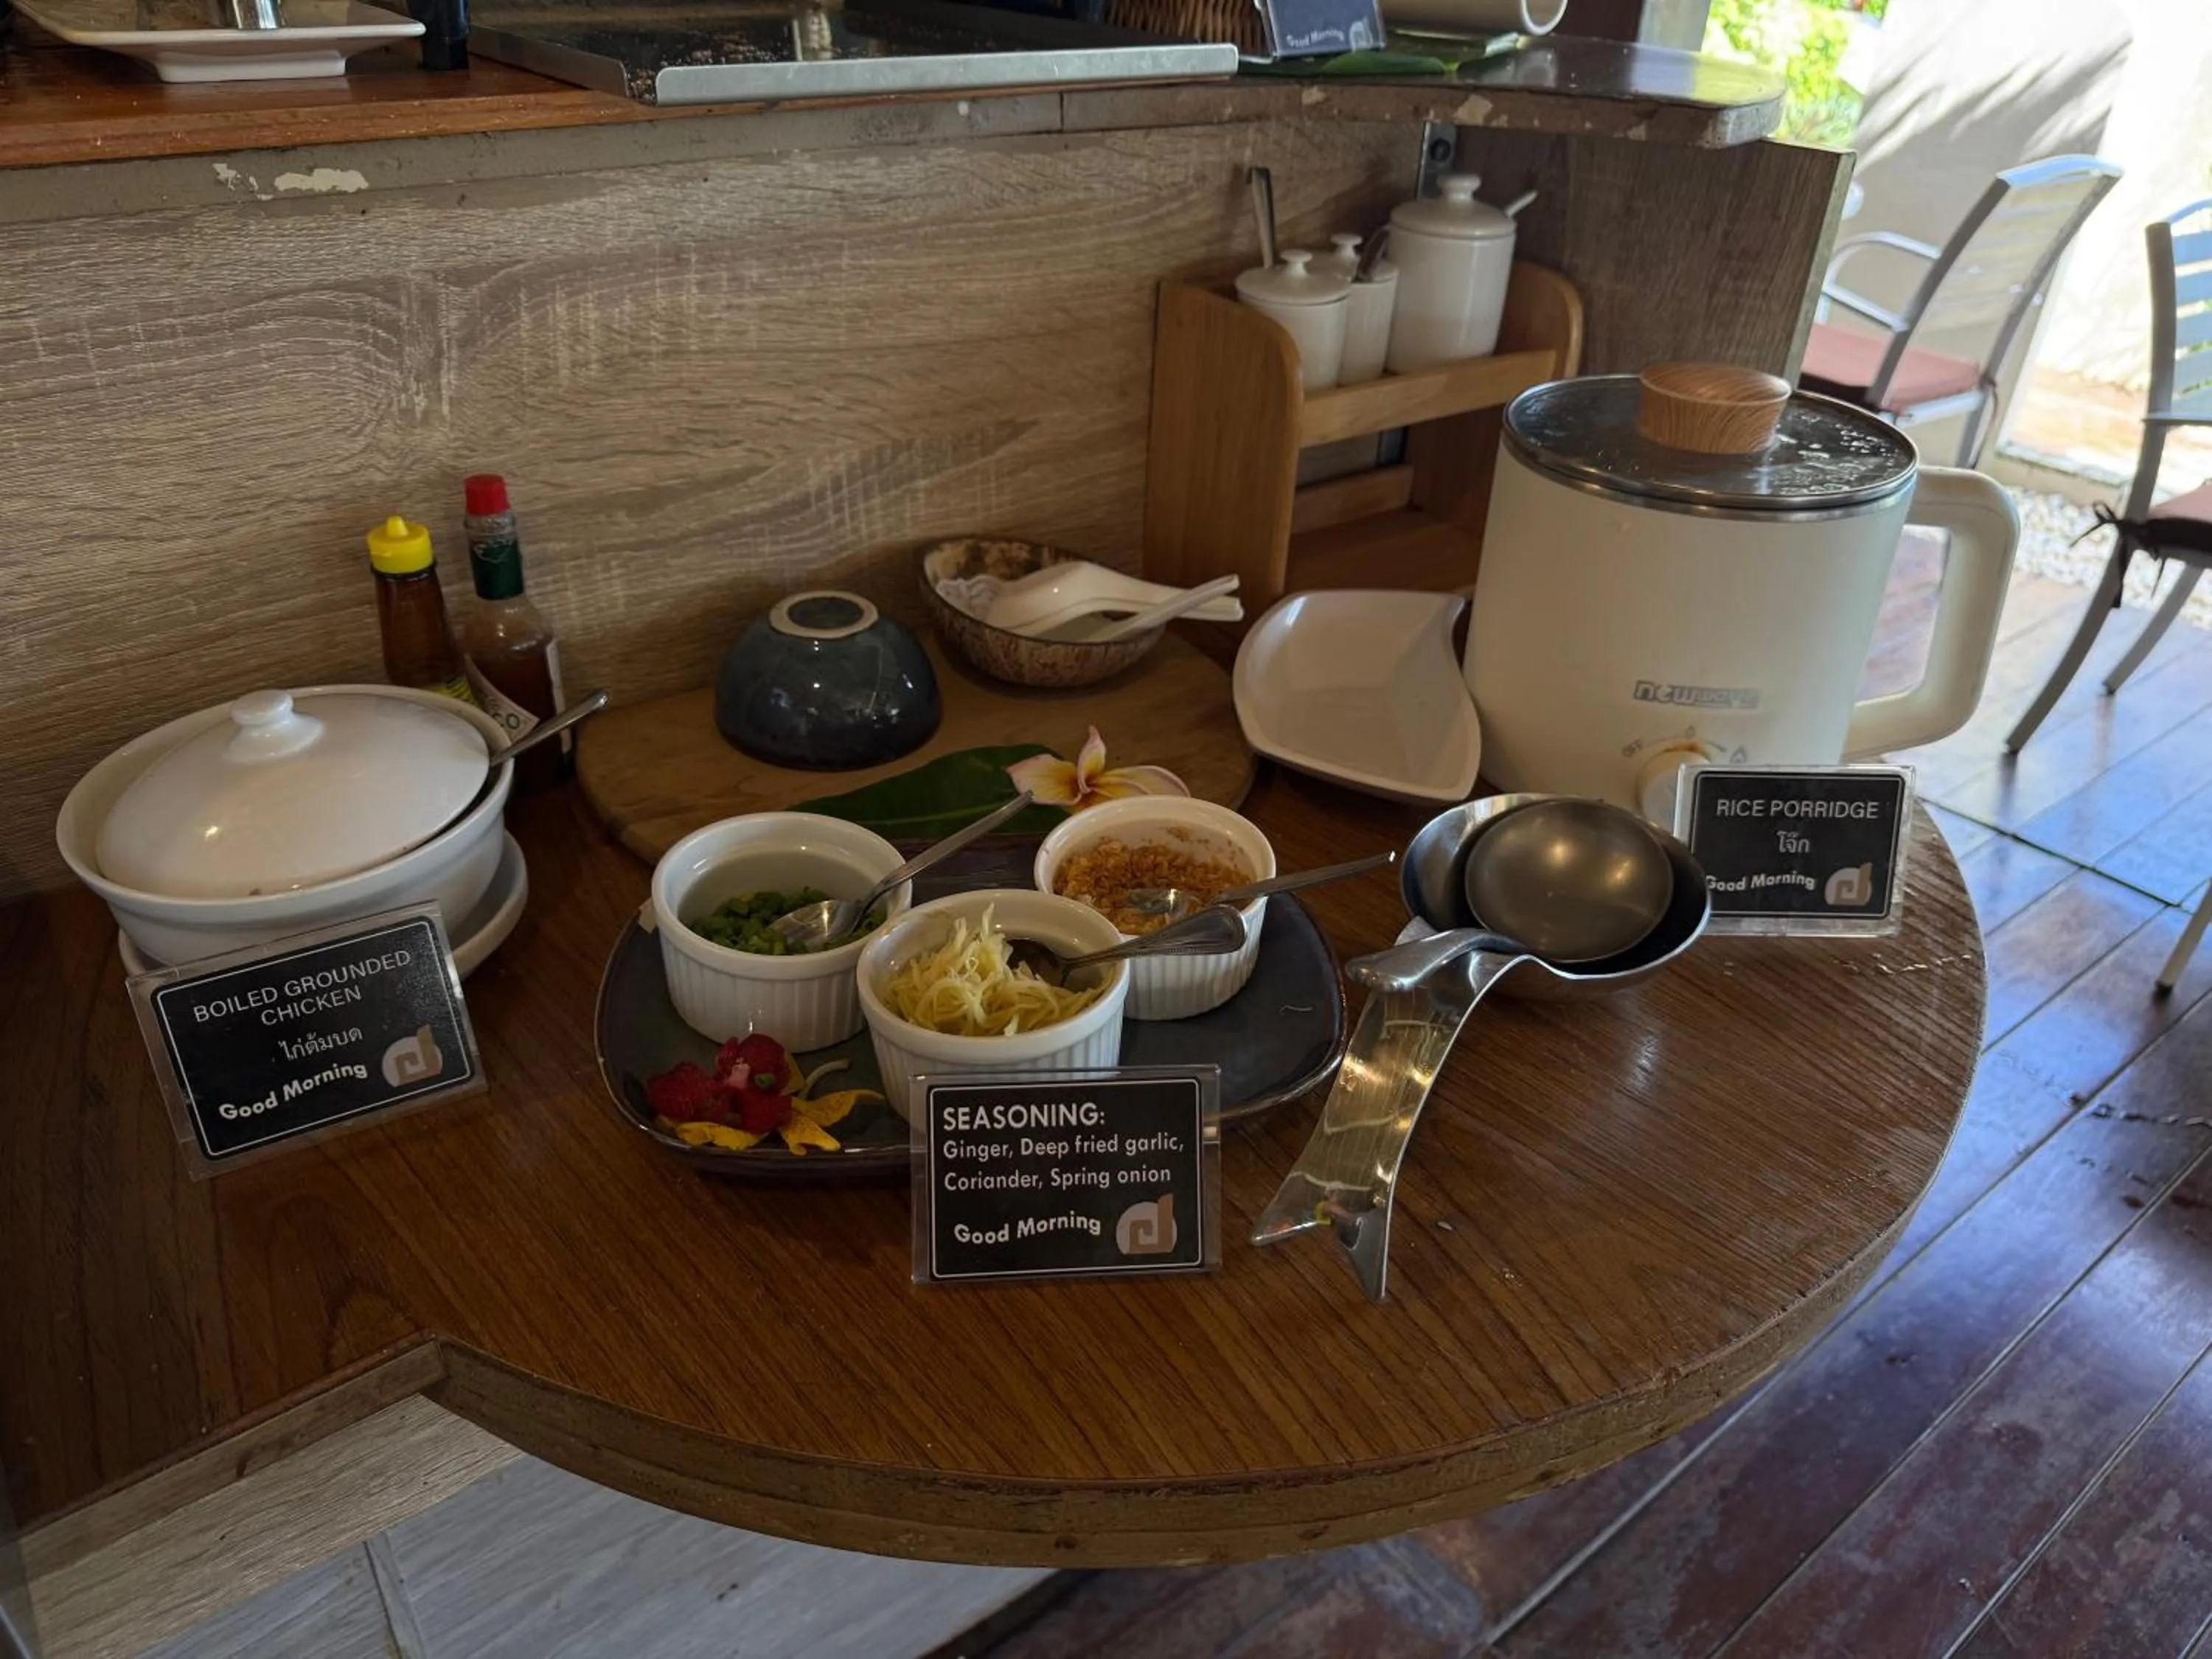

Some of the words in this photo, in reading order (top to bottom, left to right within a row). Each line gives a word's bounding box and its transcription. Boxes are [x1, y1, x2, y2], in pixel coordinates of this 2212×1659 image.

[1716, 799, 1764, 817] RICE
[1770, 800, 1879, 819] PORRIDGE
[1750, 869, 1815, 891] Morning
[193, 987, 278, 1023] BOILED
[284, 950, 411, 997] GROUNDED
[260, 984, 363, 1026] CHICKEN
[277, 1026, 364, 1062] ไก่ต้มบด
[218, 1091, 279, 1121] Good
[282, 1062, 368, 1102] Morning
[942, 1102, 1106, 1131] SEASONING:
[943, 1139, 1014, 1162] Ginger,
[1020, 1138, 1069, 1159] Deep
[1074, 1133, 1119, 1154] fried
[1124, 1132, 1184, 1157] garlic,
[944, 1169, 1043, 1192] Coriander,
[1050, 1166, 1110, 1191] Spring
[1117, 1164, 1171, 1183] onion
[953, 1223, 1010, 1245] Good
[1016, 1210, 1102, 1240] Morning
